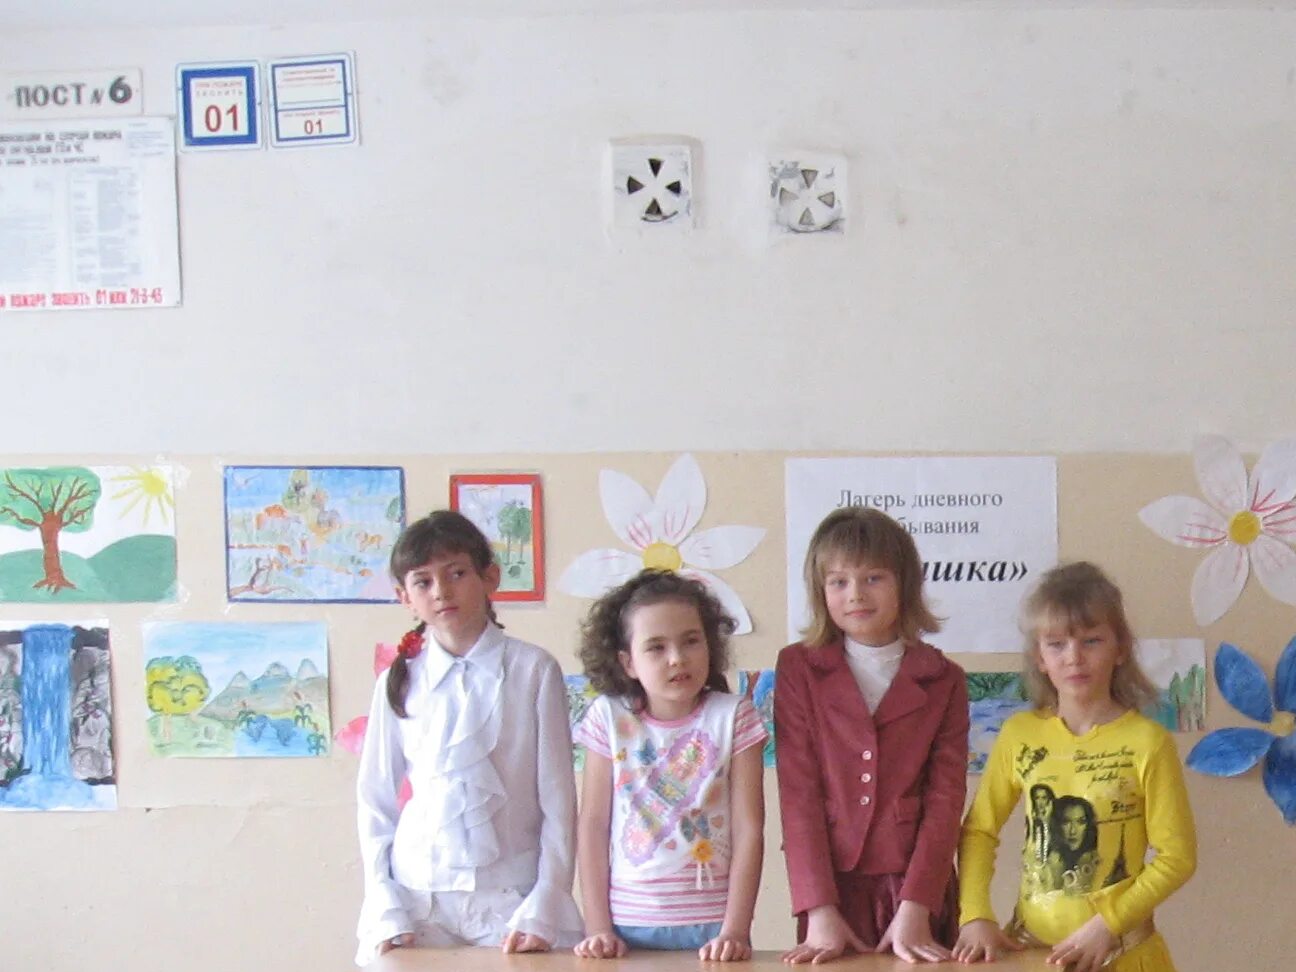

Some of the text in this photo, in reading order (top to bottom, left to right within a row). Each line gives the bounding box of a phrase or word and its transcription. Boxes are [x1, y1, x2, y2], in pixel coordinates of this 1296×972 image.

[15, 83, 86, 107] ПОСТ
[109, 75, 132, 104] 6
[205, 104, 238, 132] 01
[304, 119, 323, 135] 01
[837, 490, 1003, 510] Лагерь дневного
[897, 516, 980, 534] бывания
